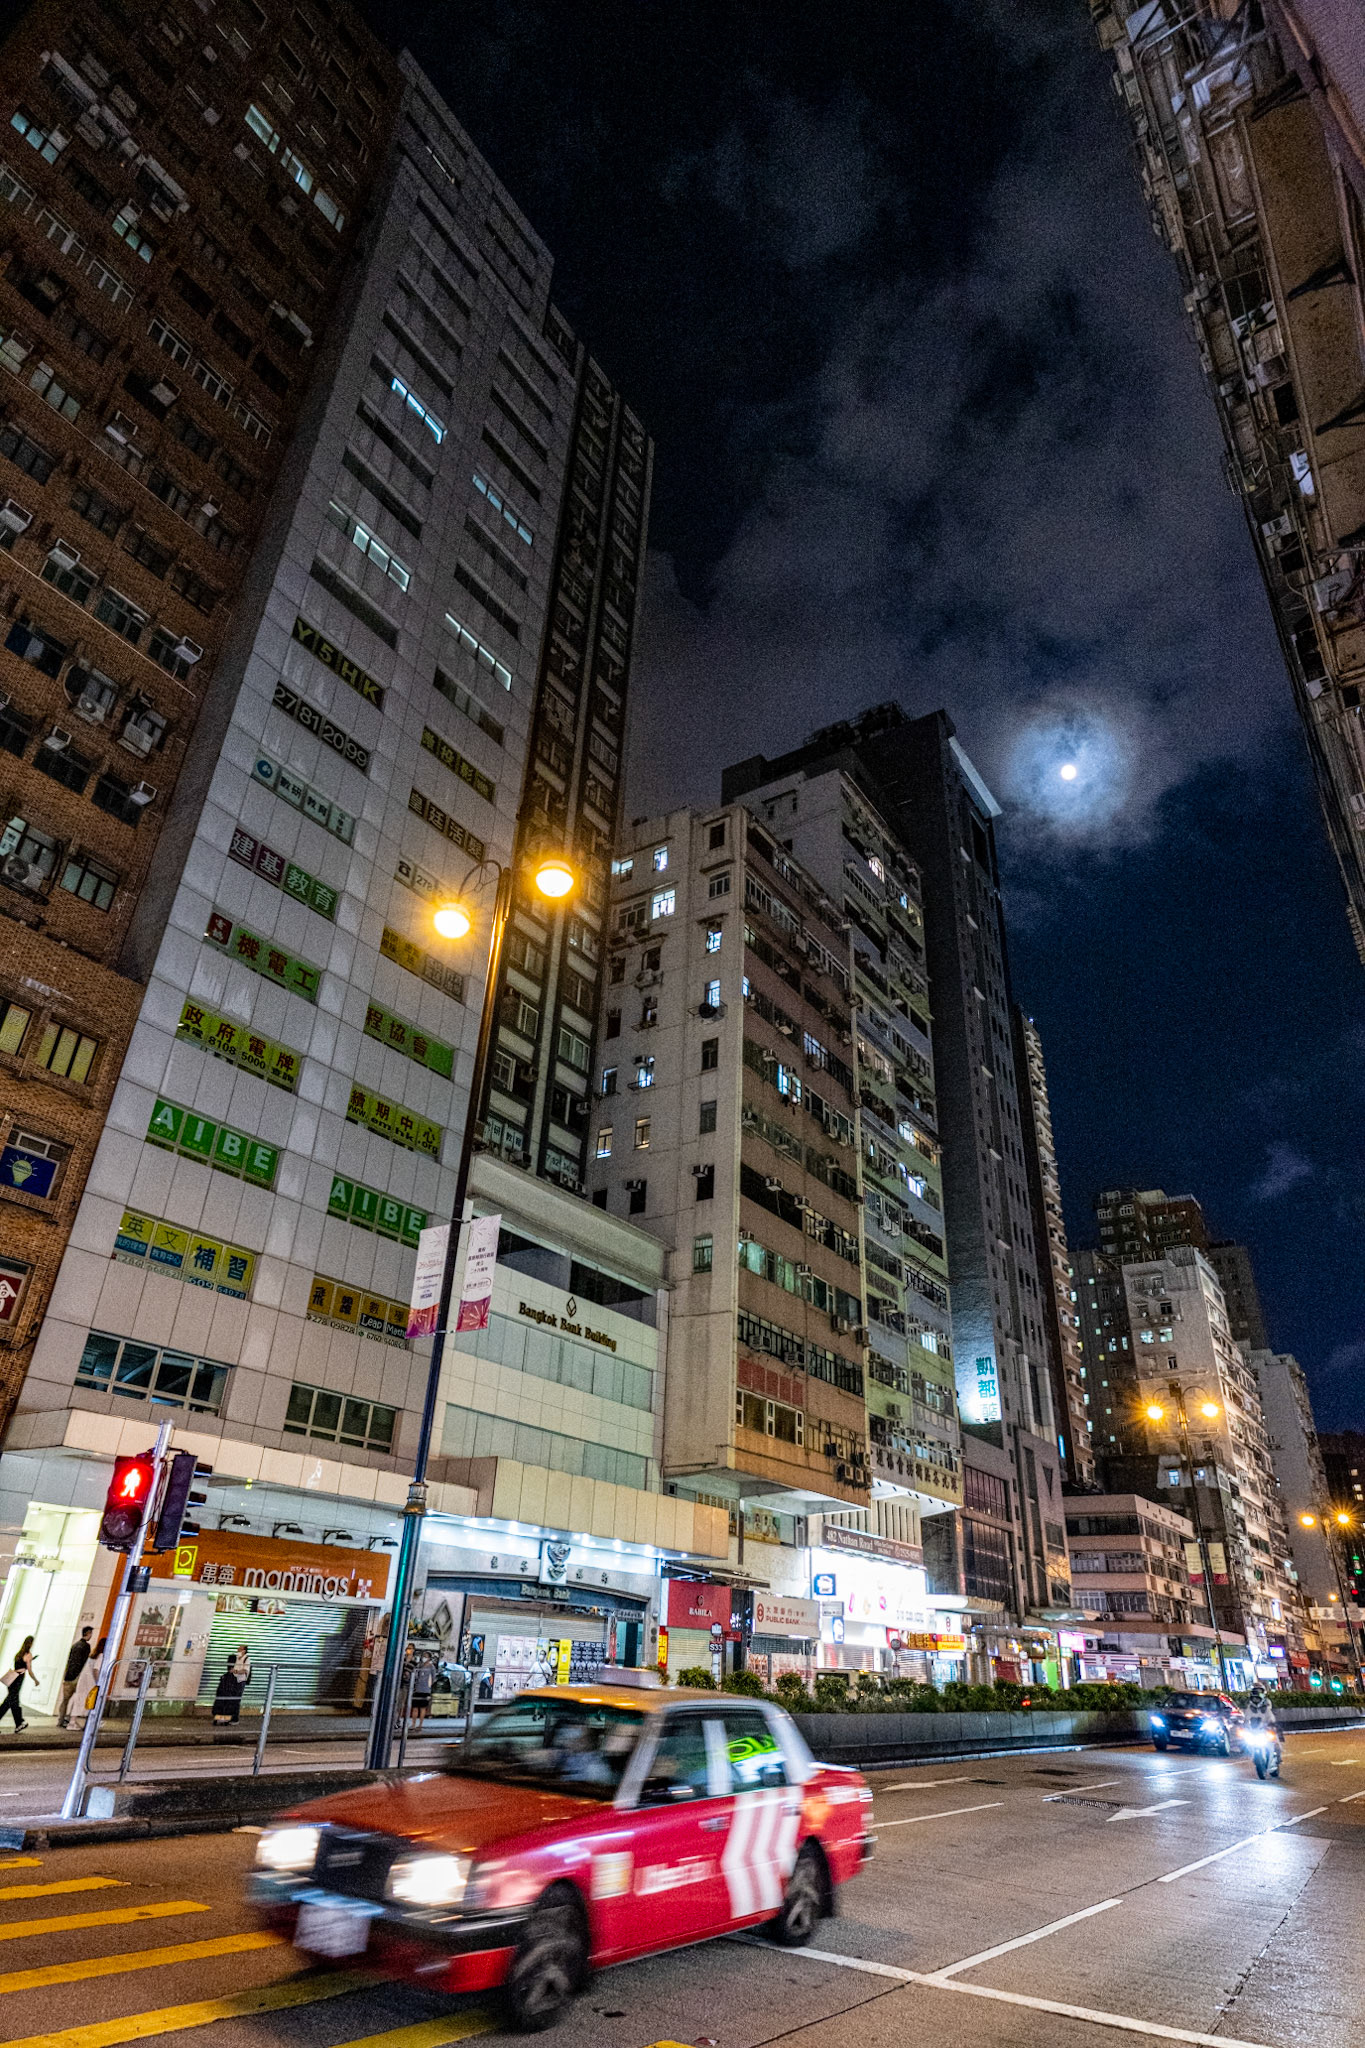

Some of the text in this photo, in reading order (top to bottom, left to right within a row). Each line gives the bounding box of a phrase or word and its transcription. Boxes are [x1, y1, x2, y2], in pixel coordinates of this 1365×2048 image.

[231, 831, 335, 911] 建基教育
[238, 933, 314, 992] 機電工
[184, 1004, 295, 1073] 政府電牌
[208, 1036, 237, 1056] 8108
[240, 1051, 267, 1070] 5000
[366, 1006, 429, 1058] 程協會
[153, 1106, 273, 1171] AIBE
[331, 1181, 423, 1233] AIBE
[125, 1215, 249, 1282] 英文補習
[518, 1301, 618, 1353] Bangkok Bank Building
[838, 1532, 859, 1548] Nathan
[859, 1537, 874, 1551] Road
[200, 1561, 236, 1585] 萬寧
[243, 1567, 349, 1602] mannings
[766, 1615, 785, 1624] PUBLIC
[709, 1643, 723, 1652] S33
